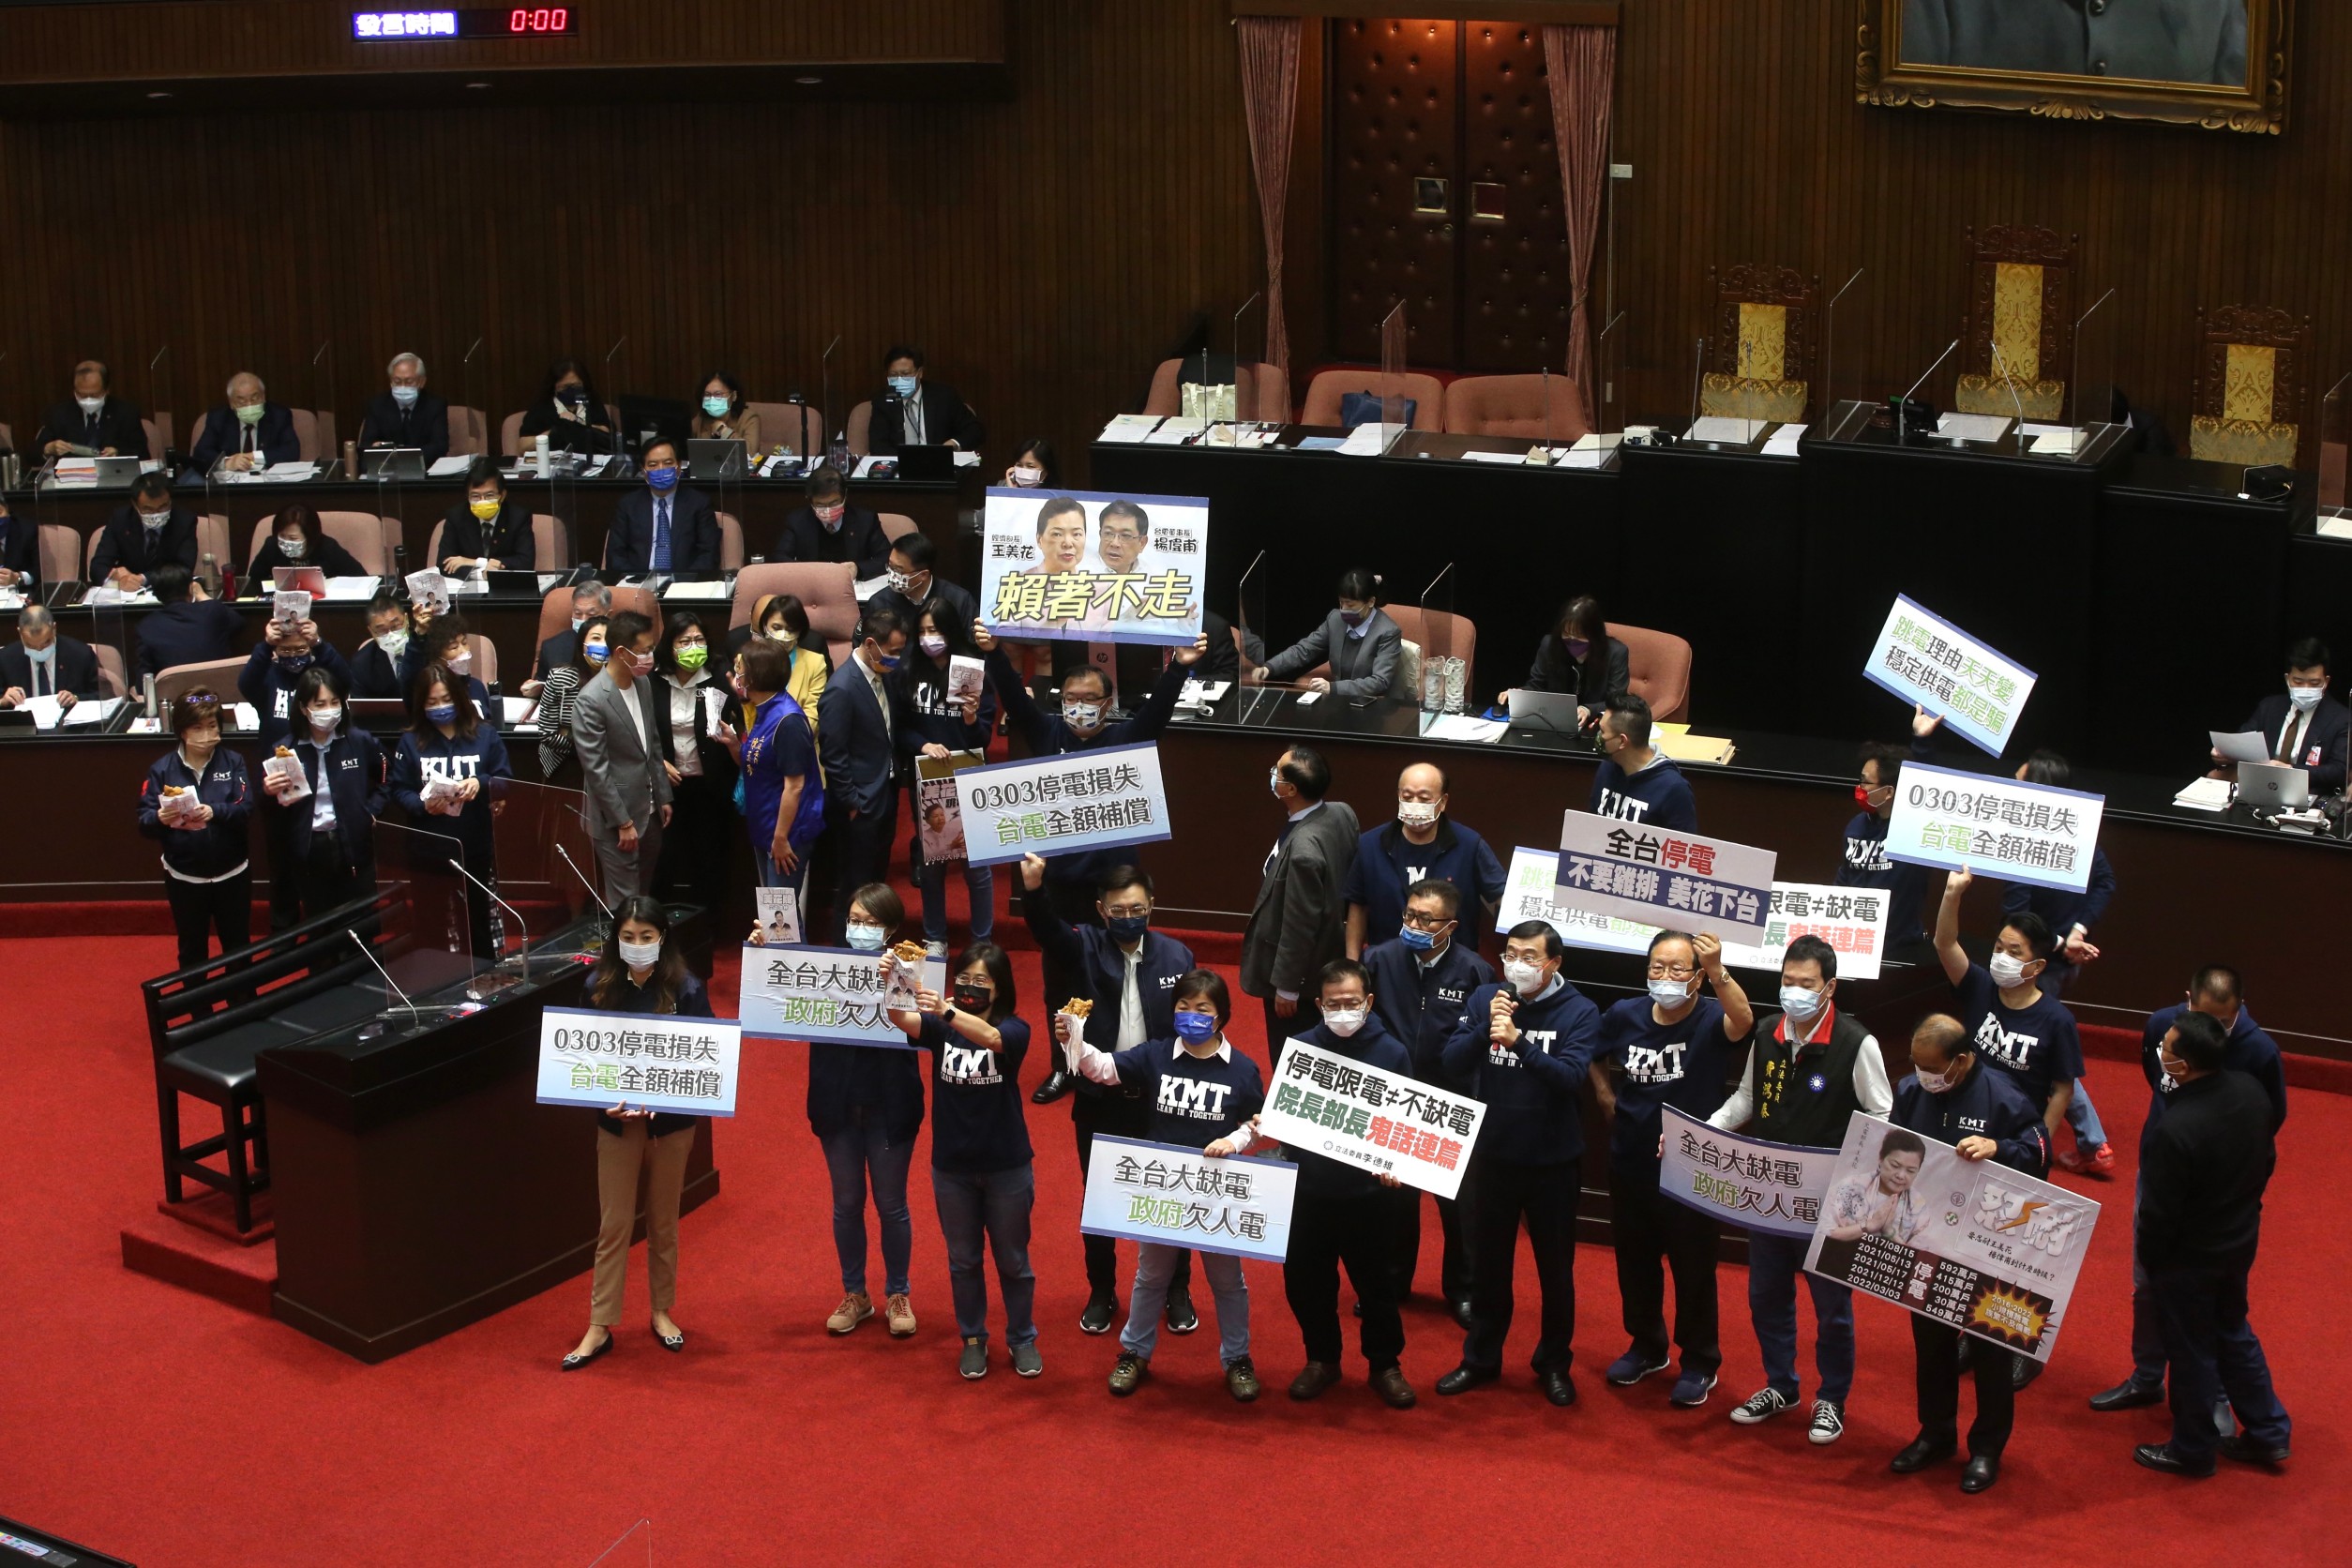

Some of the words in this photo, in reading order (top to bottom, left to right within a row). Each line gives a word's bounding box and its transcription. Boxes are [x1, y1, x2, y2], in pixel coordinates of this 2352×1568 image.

[355, 13, 455, 36] 發言時間
[511, 9, 566, 32] 0:00
[991, 544, 1035, 560] 王美花
[1153, 537, 1199, 554] 楊偉甫
[992, 569, 1193, 621] 賴著不走
[1891, 615, 2017, 705] 跳電理由天天變
[1884, 644, 2007, 735] 穩定供電都是騙
[213, 771, 232, 779] KMT
[341, 758, 359, 767] KMT
[972, 764, 1142, 810] 0303停電損失
[996, 797, 1153, 844] 台電全額補償
[1908, 784, 2078, 837] 0303停電損失
[1606, 828, 1716, 876] 全台停電
[1921, 820, 2075, 874] 台電全額補償
[1568, 855, 1659, 901] 不要雞排
[1666, 877, 1760, 923] 美花下台
[1439, 987, 1465, 999] KMT
[784, 996, 896, 1031] 政府欠人
[554, 1028, 718, 1063] 0303停電損失
[1978, 1012, 2039, 1064] KMT
[1625, 1042, 1686, 1076] KMT
[570, 1063, 721, 1098] 台電全額補償
[967, 1075, 1003, 1085] TOGETHER
[1158, 1074, 1231, 1113] KMT
[1287, 1049, 1476, 1137] 停電限電≠不缺電
[1156, 1103, 1173, 1114] LEAN
[1177, 1108, 1185, 1116] IN
[1189, 1109, 1226, 1121] TOGETHER
[1273, 1082, 1463, 1170] 院長部長鬼話連篇
[1959, 1116, 1986, 1128] KMT
[1334, 1145, 1395, 1170] 立法委員李德維
[1680, 1129, 1802, 1187] 全台大缺電
[1114, 1155, 1252, 1200] 全台大缺電
[1693, 1169, 1820, 1223] 政府欠人電
[1127, 1195, 1266, 1241] 政府欠人電
[1858, 1243, 1912, 1269] 2021/05/13
[1862, 1232, 1915, 1259] 2017/08/15
[1850, 1264, 1905, 1289] 2021/12/12
[1854, 1253, 1907, 1278] 2021/05/17
[1939, 1261, 1978, 1281] 592萬戶
[1847, 1274, 1901, 1300] 2022/03/03
[1907, 1261, 1933, 1301] 停電
[1932, 1283, 1971, 1302] 200萬戶
[1936, 1273, 1974, 1291] 415萬戶
[1925, 1304, 1964, 1324] 549萬戶
[1934, 1295, 1967, 1313] 30萬戶
[1992, 1295, 2032, 1319] 2016-2022
